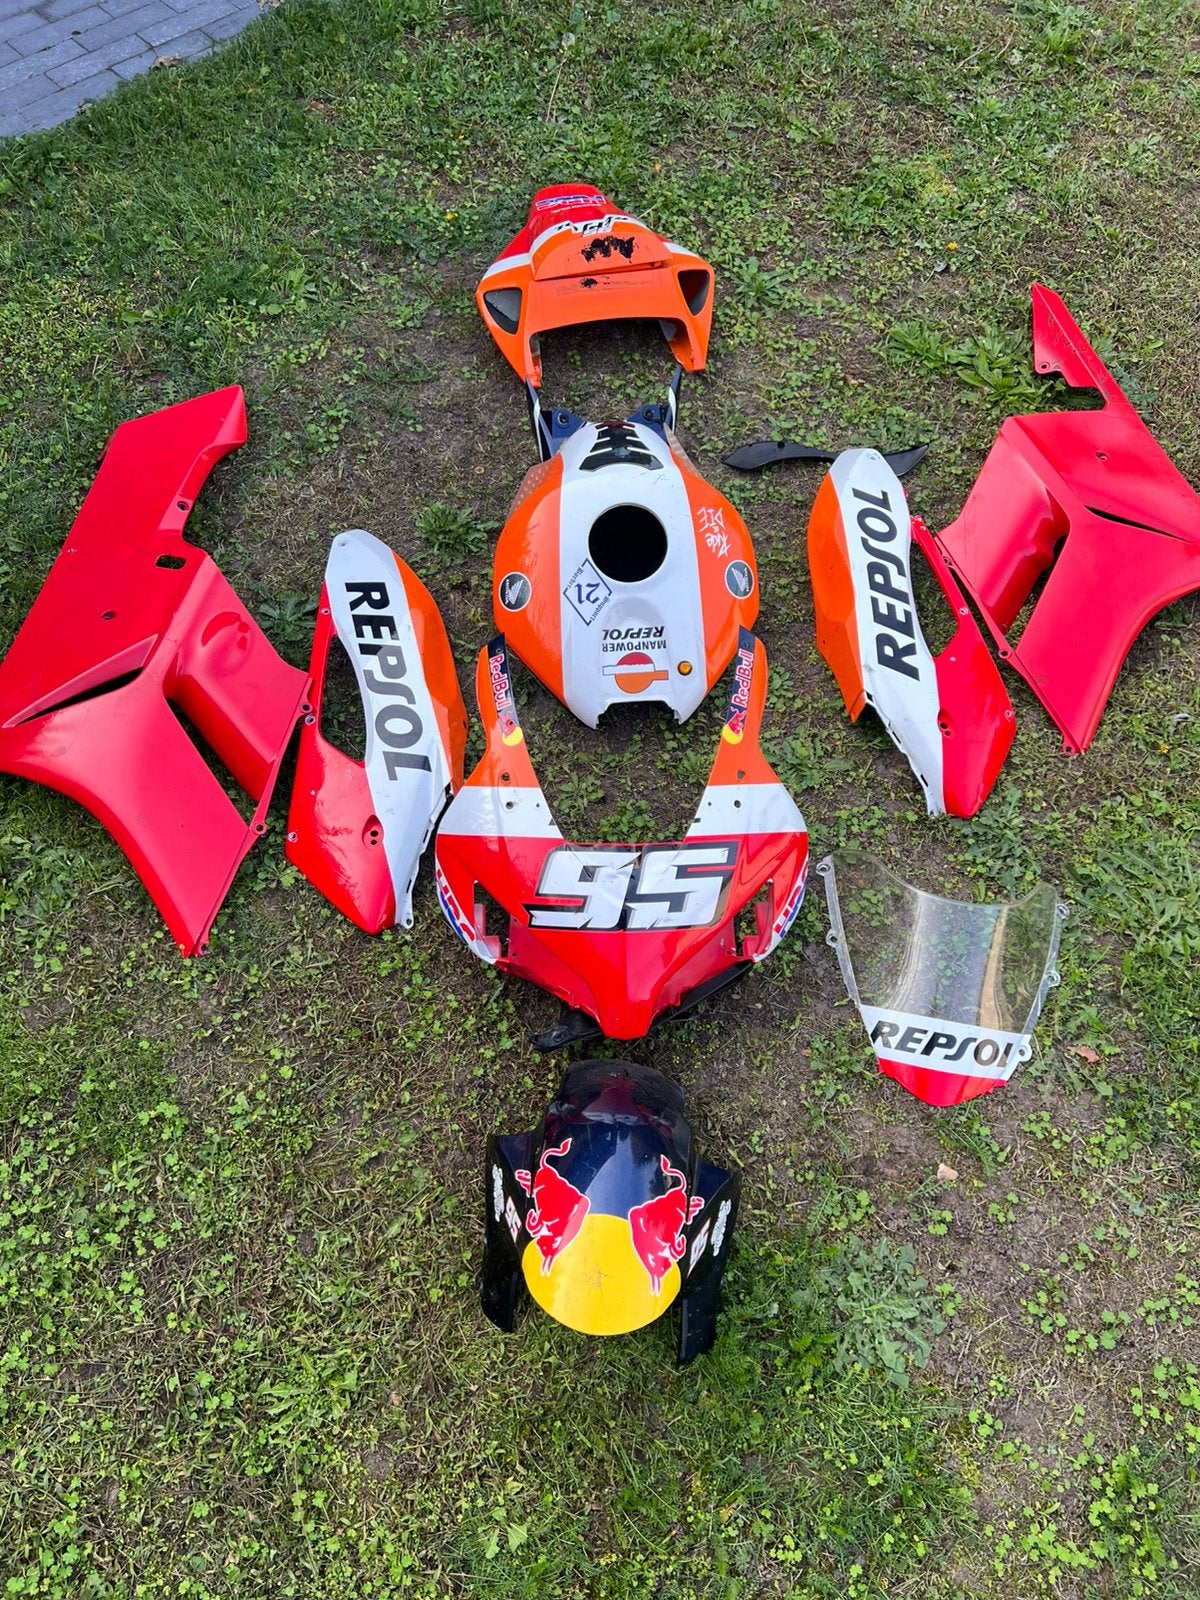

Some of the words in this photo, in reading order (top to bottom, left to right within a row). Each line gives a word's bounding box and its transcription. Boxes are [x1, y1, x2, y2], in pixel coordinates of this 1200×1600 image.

[574, 582, 600, 604] 21
[852, 487, 920, 682] REPSOL
[602, 626, 664, 640] REPSOL
[602, 639, 667, 652] MANPOWER
[344, 581, 432, 782] REPSOL
[527, 843, 733, 931] 95
